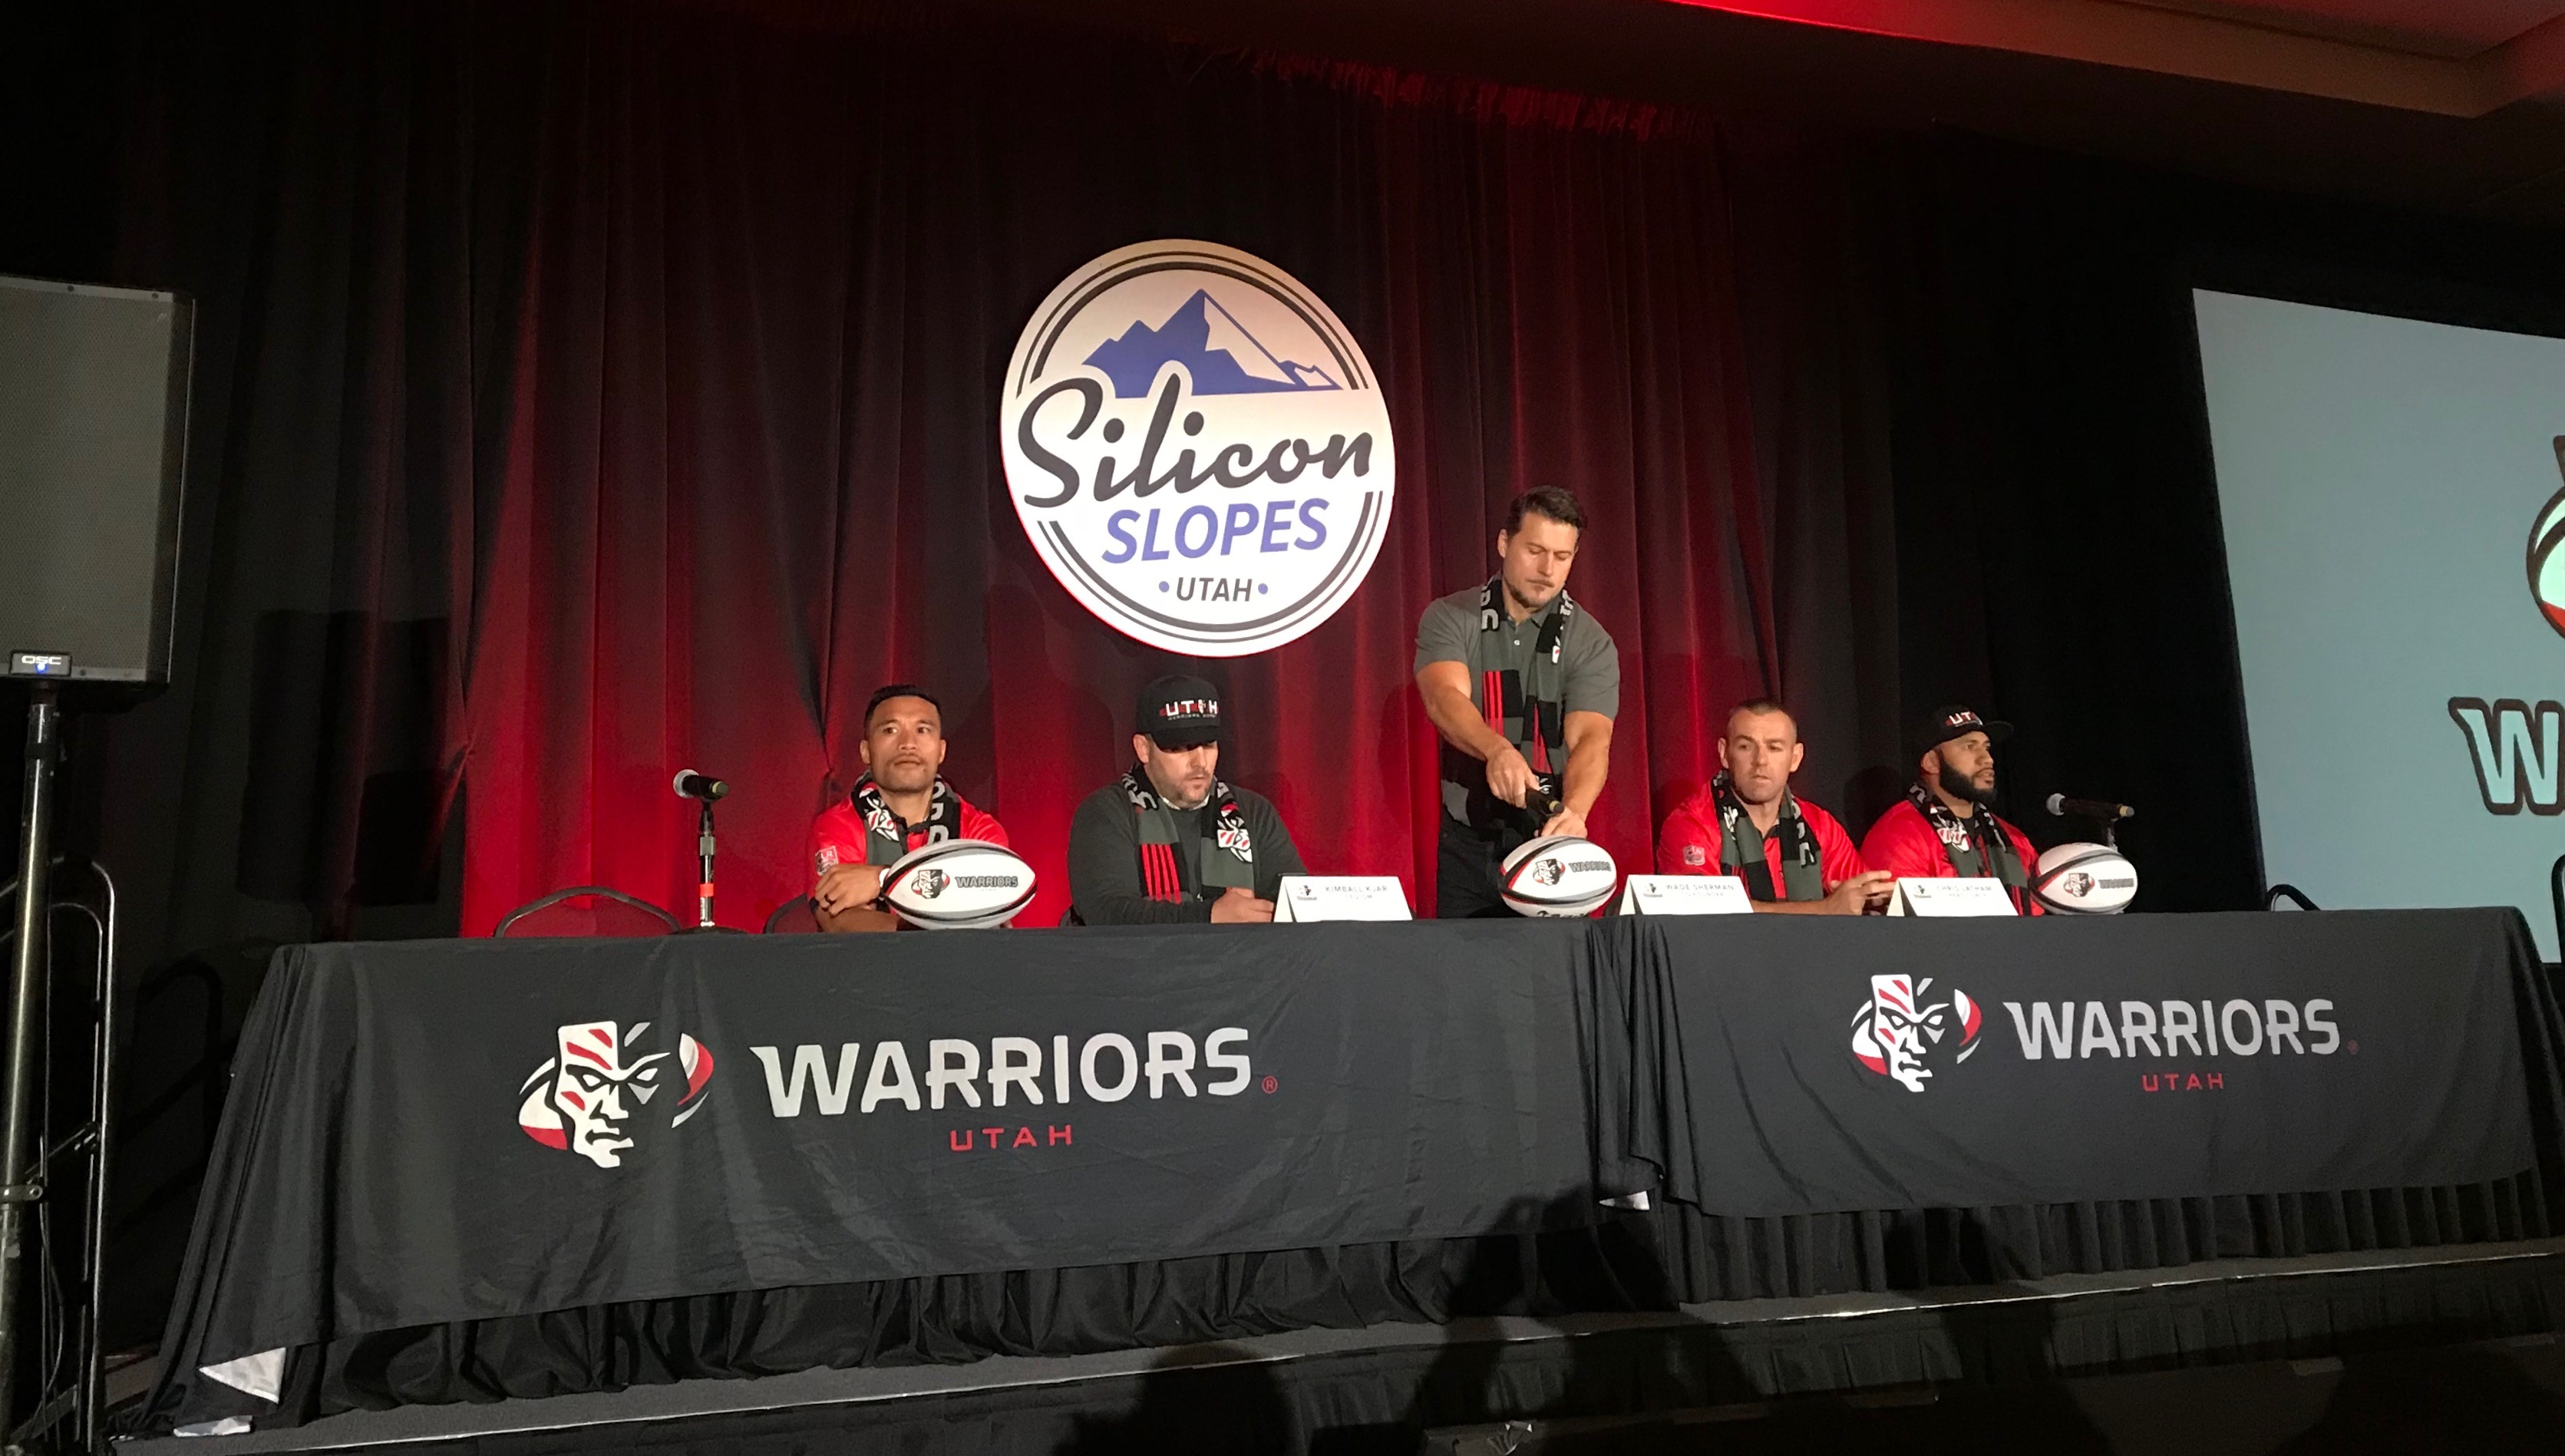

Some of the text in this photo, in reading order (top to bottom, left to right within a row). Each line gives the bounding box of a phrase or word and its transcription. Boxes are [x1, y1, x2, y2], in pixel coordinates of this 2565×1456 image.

[1018, 373, 1372, 508] Silicon
[1101, 498, 1330, 563] SLOPES
[1177, 577, 1253, 602] UTAH
[955, 876, 1018, 888] WARRIORS
[2003, 999, 2340, 1060] WARRIORS
[750, 1027, 1251, 1118] WARRIORS
[2141, 1073, 2223, 1092] UTAH
[949, 1124, 1072, 1151] UTAH
